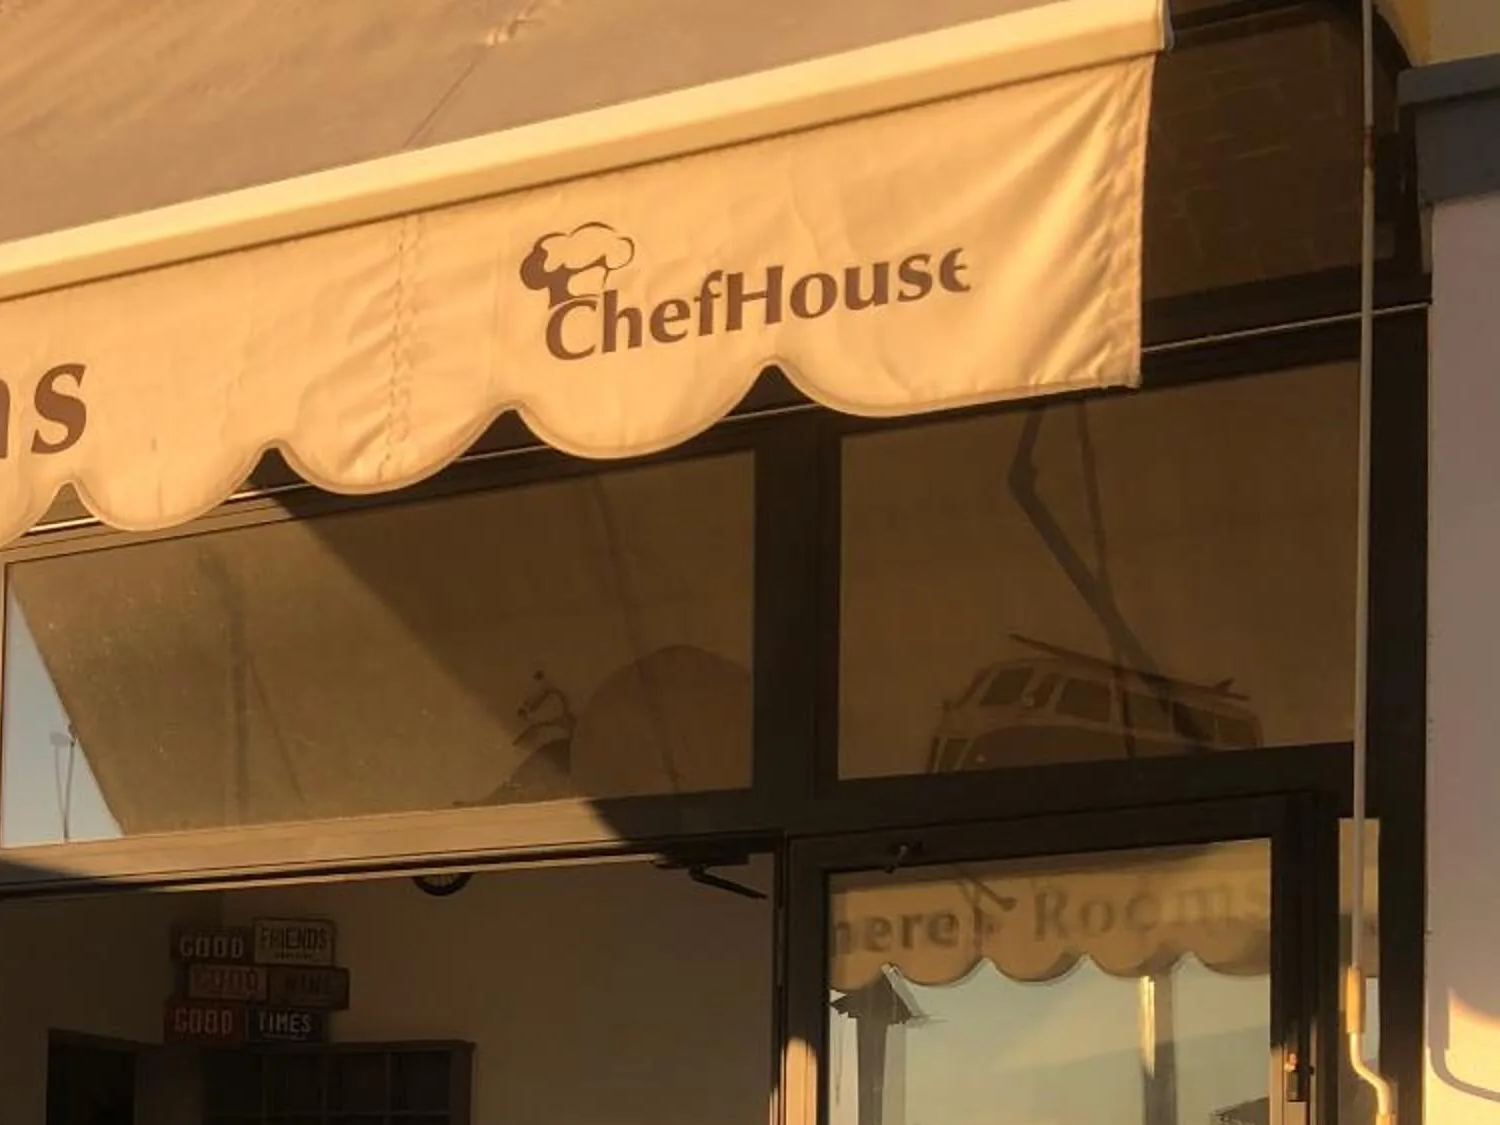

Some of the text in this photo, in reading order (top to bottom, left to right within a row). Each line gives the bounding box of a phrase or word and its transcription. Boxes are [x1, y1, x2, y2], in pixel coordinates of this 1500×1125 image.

[545, 247, 971, 361] ChefHouse
[179, 926, 329, 960] GOOD FRIENDS
[173, 1006, 312, 1035] GOOD TIMES
